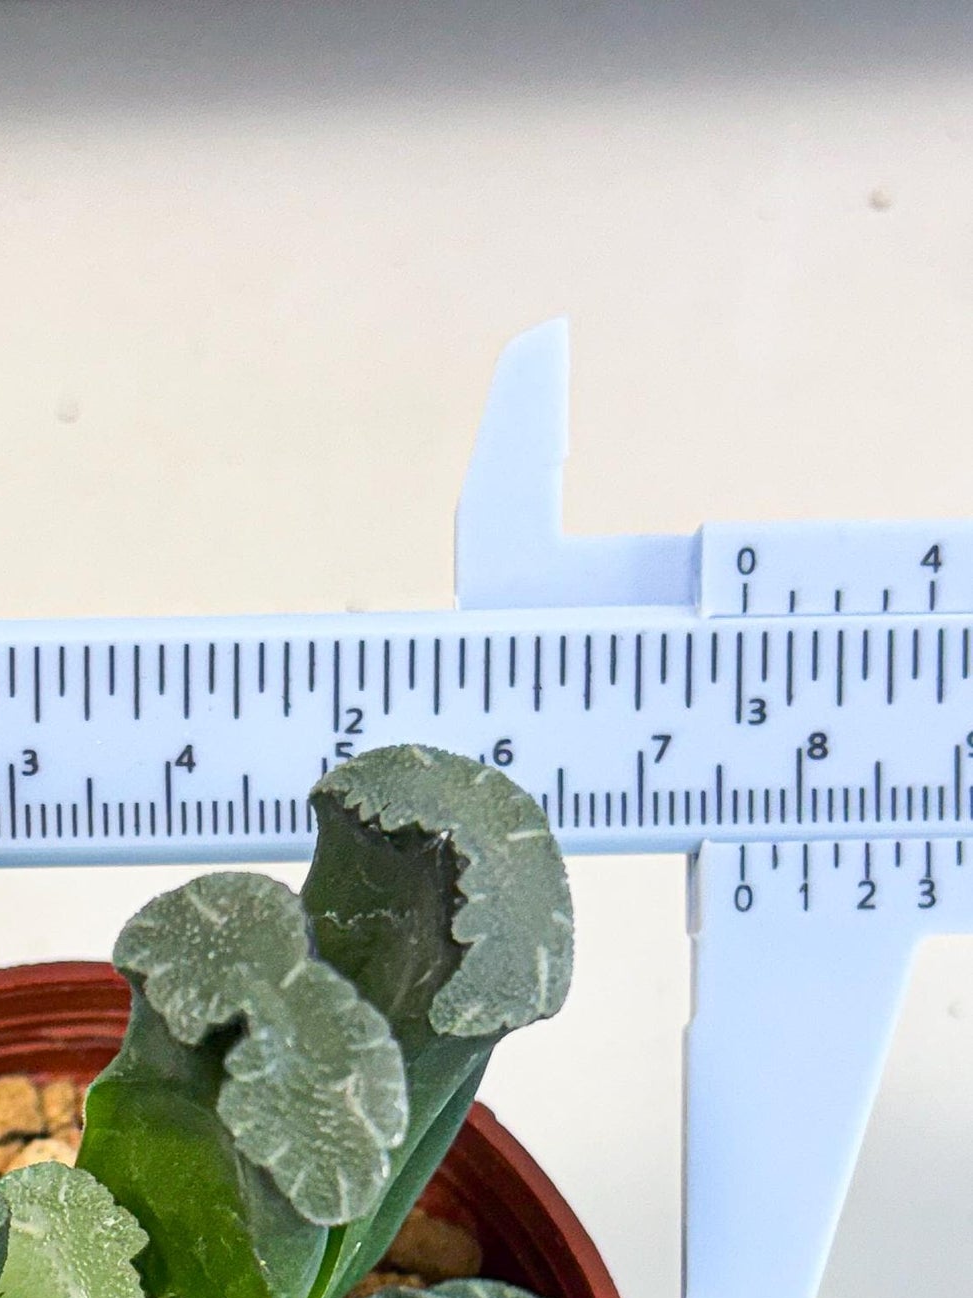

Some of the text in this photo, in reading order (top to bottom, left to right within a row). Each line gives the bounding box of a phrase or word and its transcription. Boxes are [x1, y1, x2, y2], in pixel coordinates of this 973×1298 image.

[737, 544, 942, 575] 0 4
[344, 708, 363, 735] 2
[748, 698, 767, 726] 3
[21, 749, 39, 776] 3
[174, 744, 196, 773] 4
[492, 739, 513, 766] 6
[651, 734, 672, 763] 7
[806, 731, 829, 760] 8
[734, 880, 937, 912] 0 1 2 3
